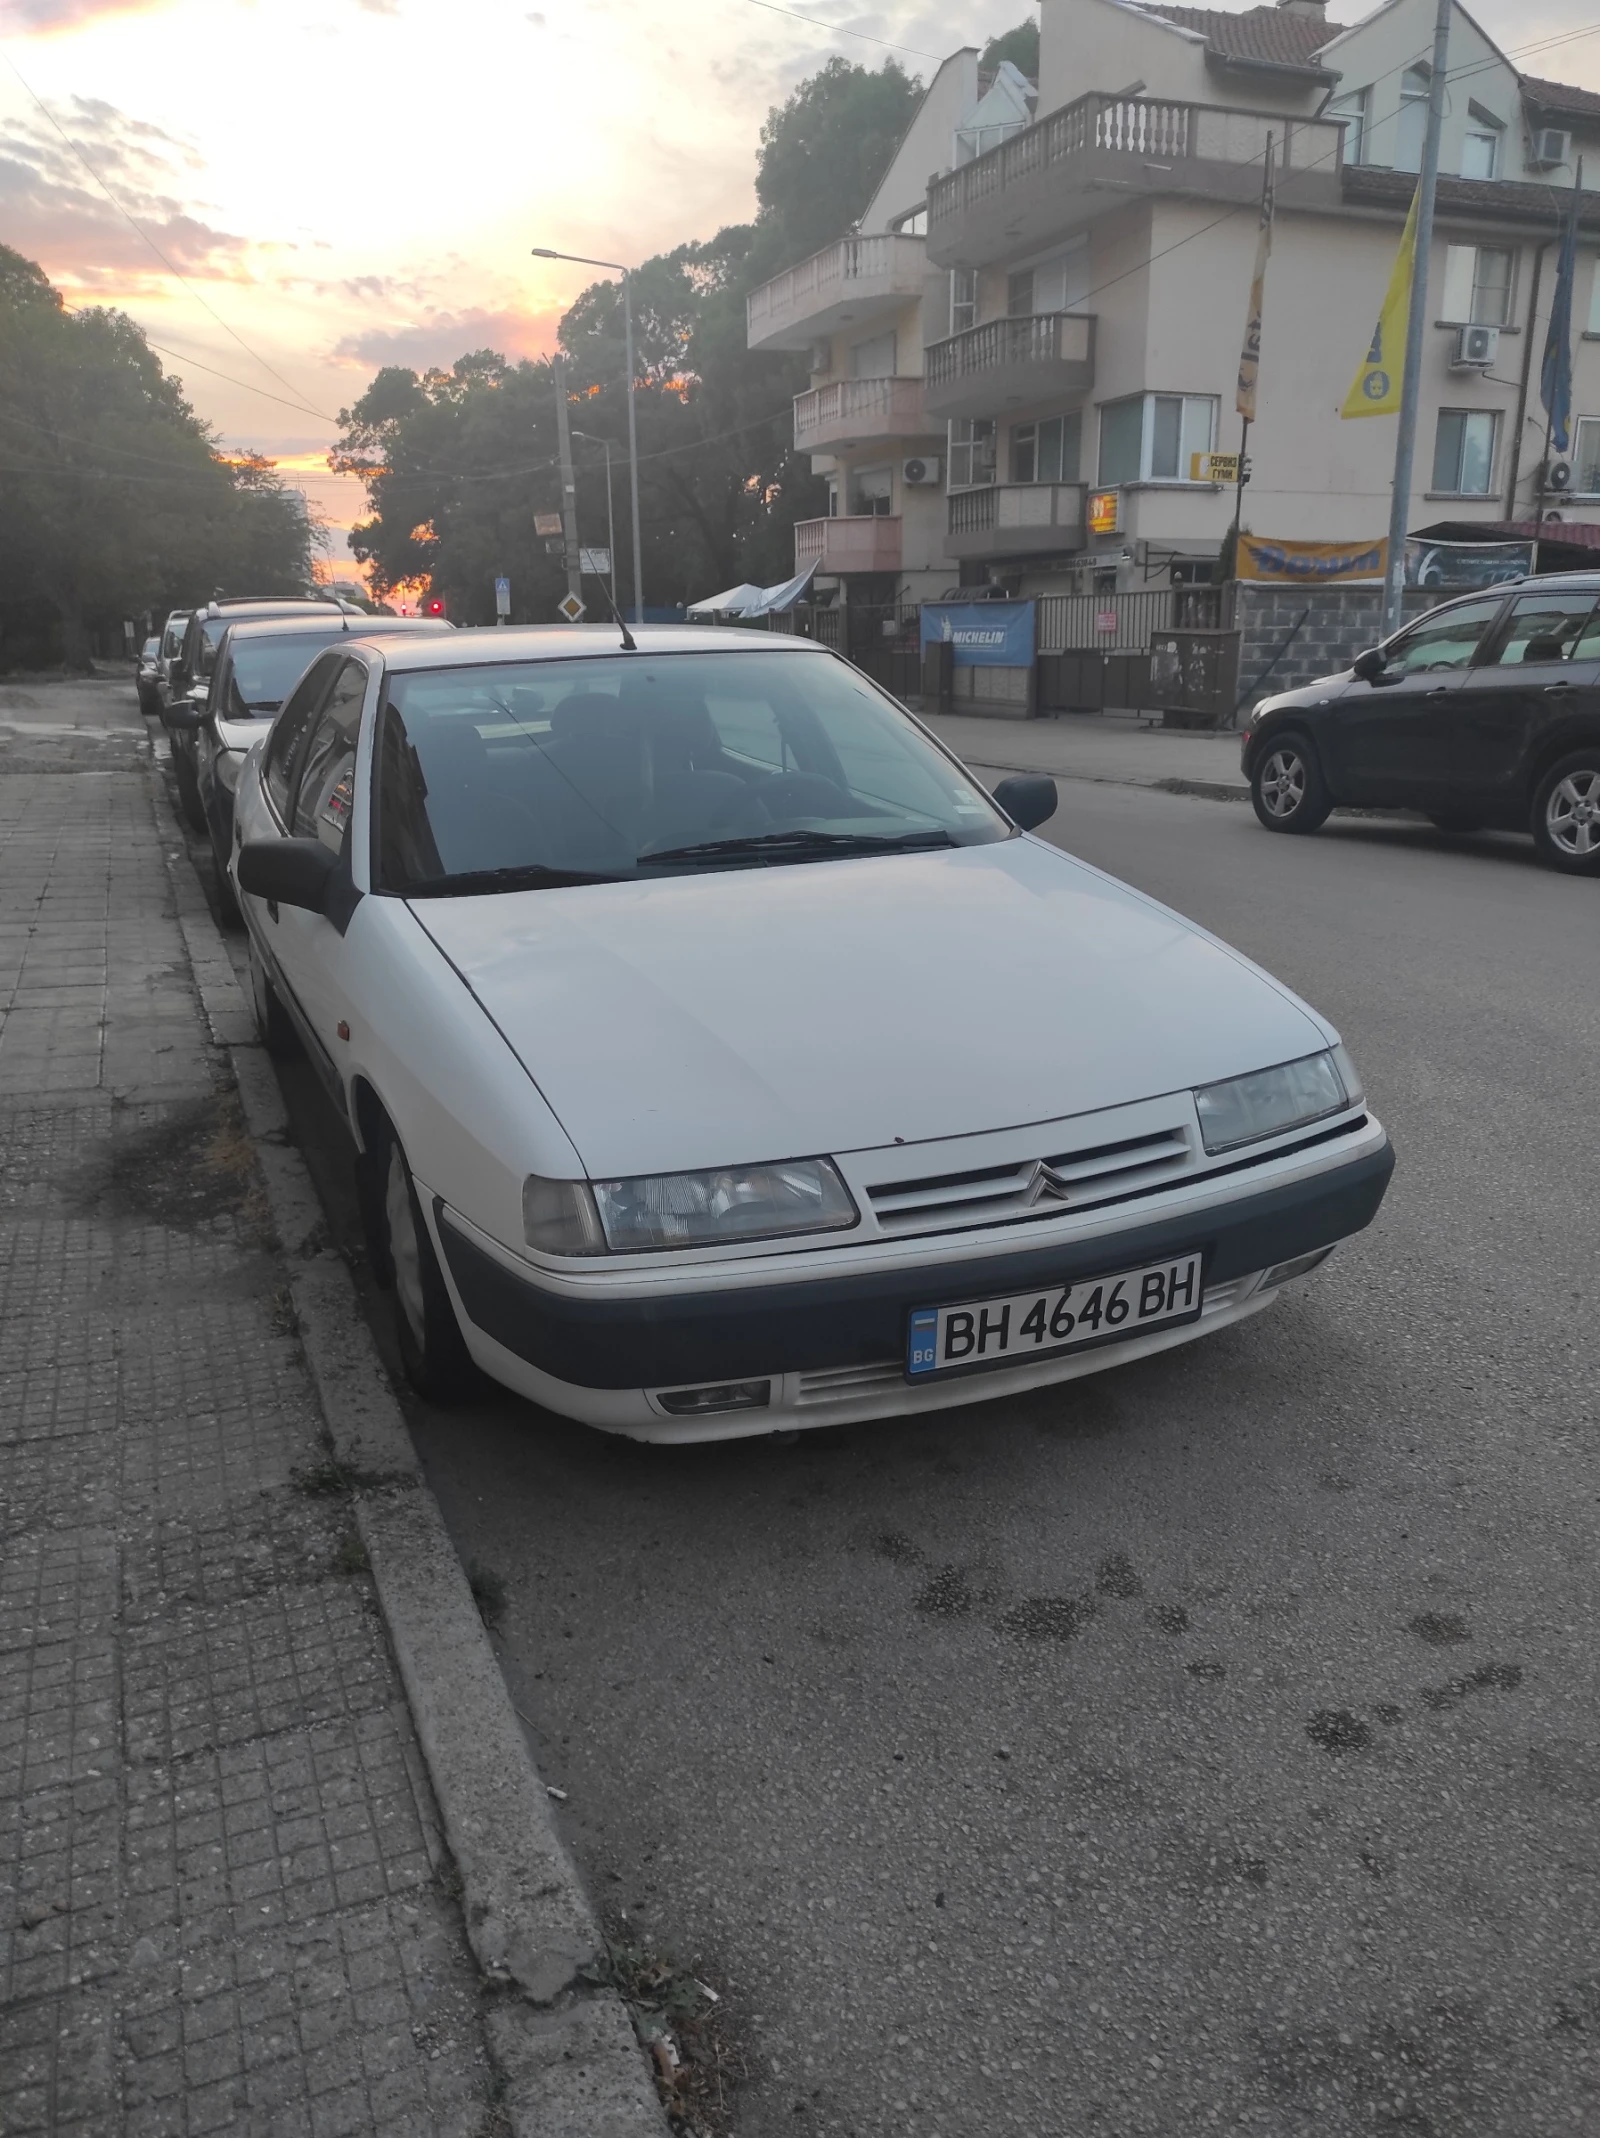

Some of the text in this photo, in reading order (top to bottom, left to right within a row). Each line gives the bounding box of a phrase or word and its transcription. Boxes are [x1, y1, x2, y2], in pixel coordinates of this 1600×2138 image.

[1210, 455, 1237, 467] СЕРВИЗ
[1212, 469, 1233, 479] ГУМИ
[952, 631, 1004, 643] MICHELIN
[944, 1261, 1195, 1360] BH 4646 BH
[912, 1348, 934, 1364] BG
